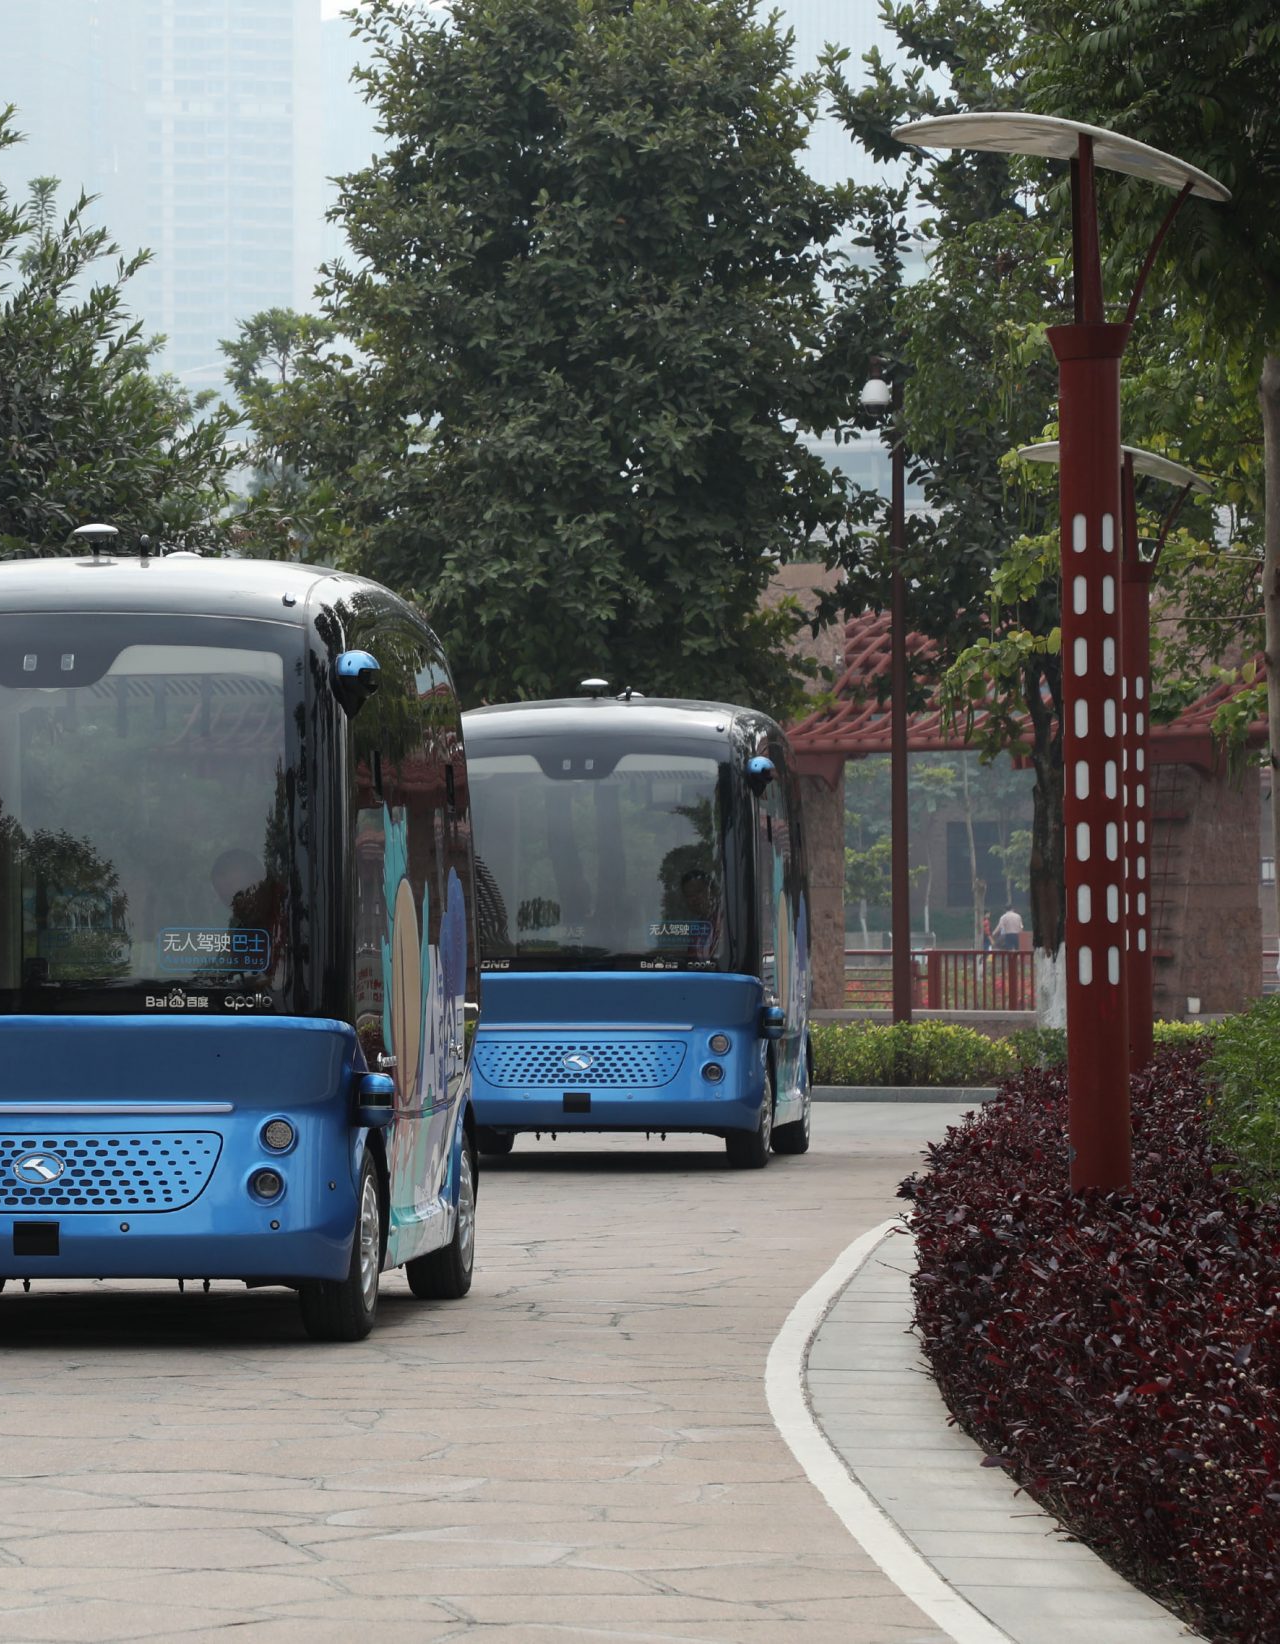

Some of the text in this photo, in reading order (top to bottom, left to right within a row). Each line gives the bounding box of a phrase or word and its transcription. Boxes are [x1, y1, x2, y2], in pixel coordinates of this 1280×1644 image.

[163, 932, 265, 953] 无人驾驶巴士
[244, 954, 264, 965] Bus
[224, 992, 273, 1010] apollo
